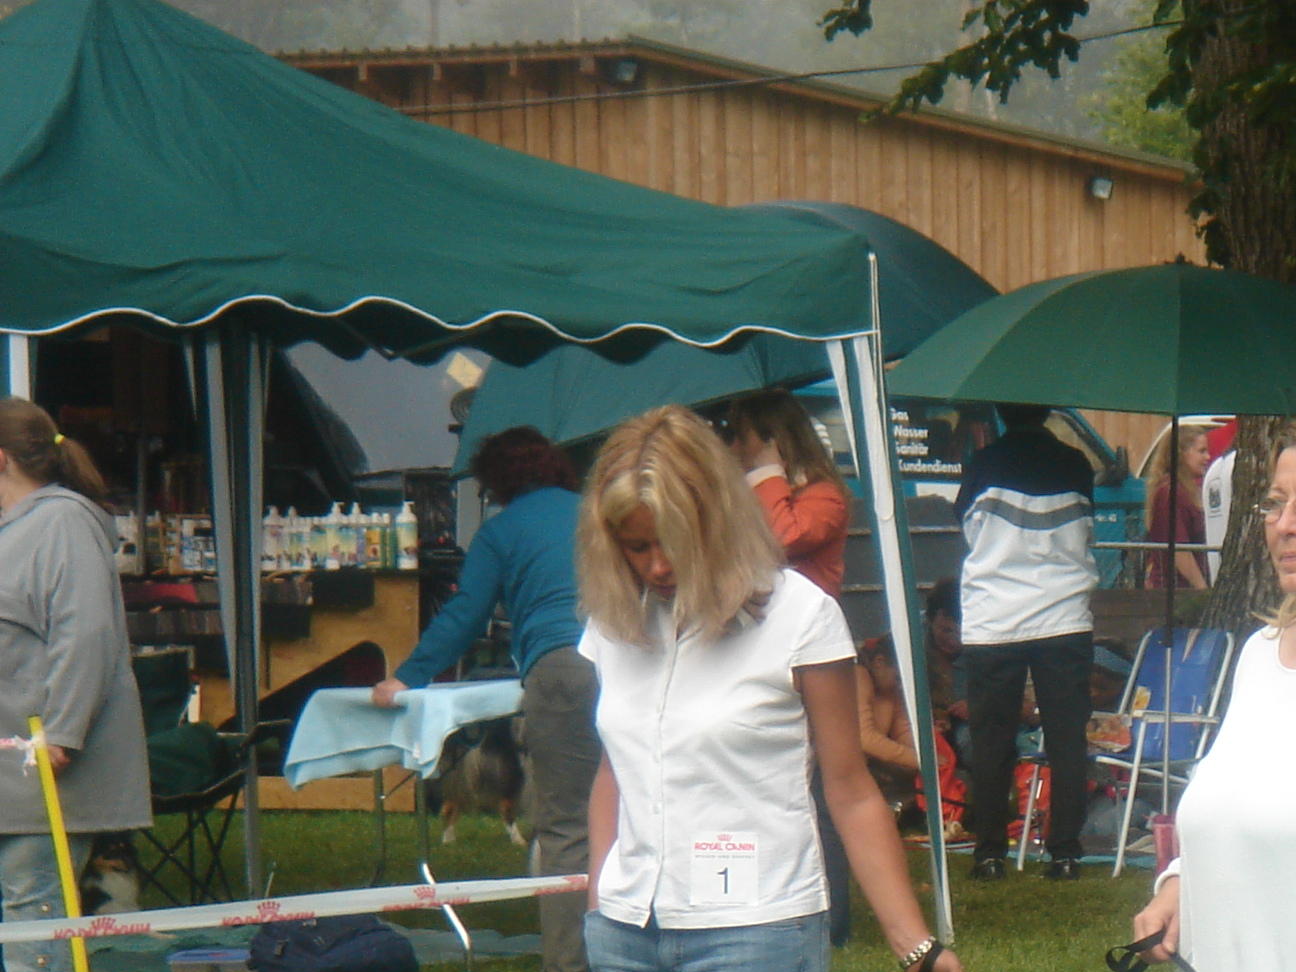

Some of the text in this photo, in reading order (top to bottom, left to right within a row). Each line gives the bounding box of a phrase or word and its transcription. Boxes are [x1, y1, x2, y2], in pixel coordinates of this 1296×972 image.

[694, 842, 755, 851] ROYAL CANIN
[717, 866, 729, 895] 1
